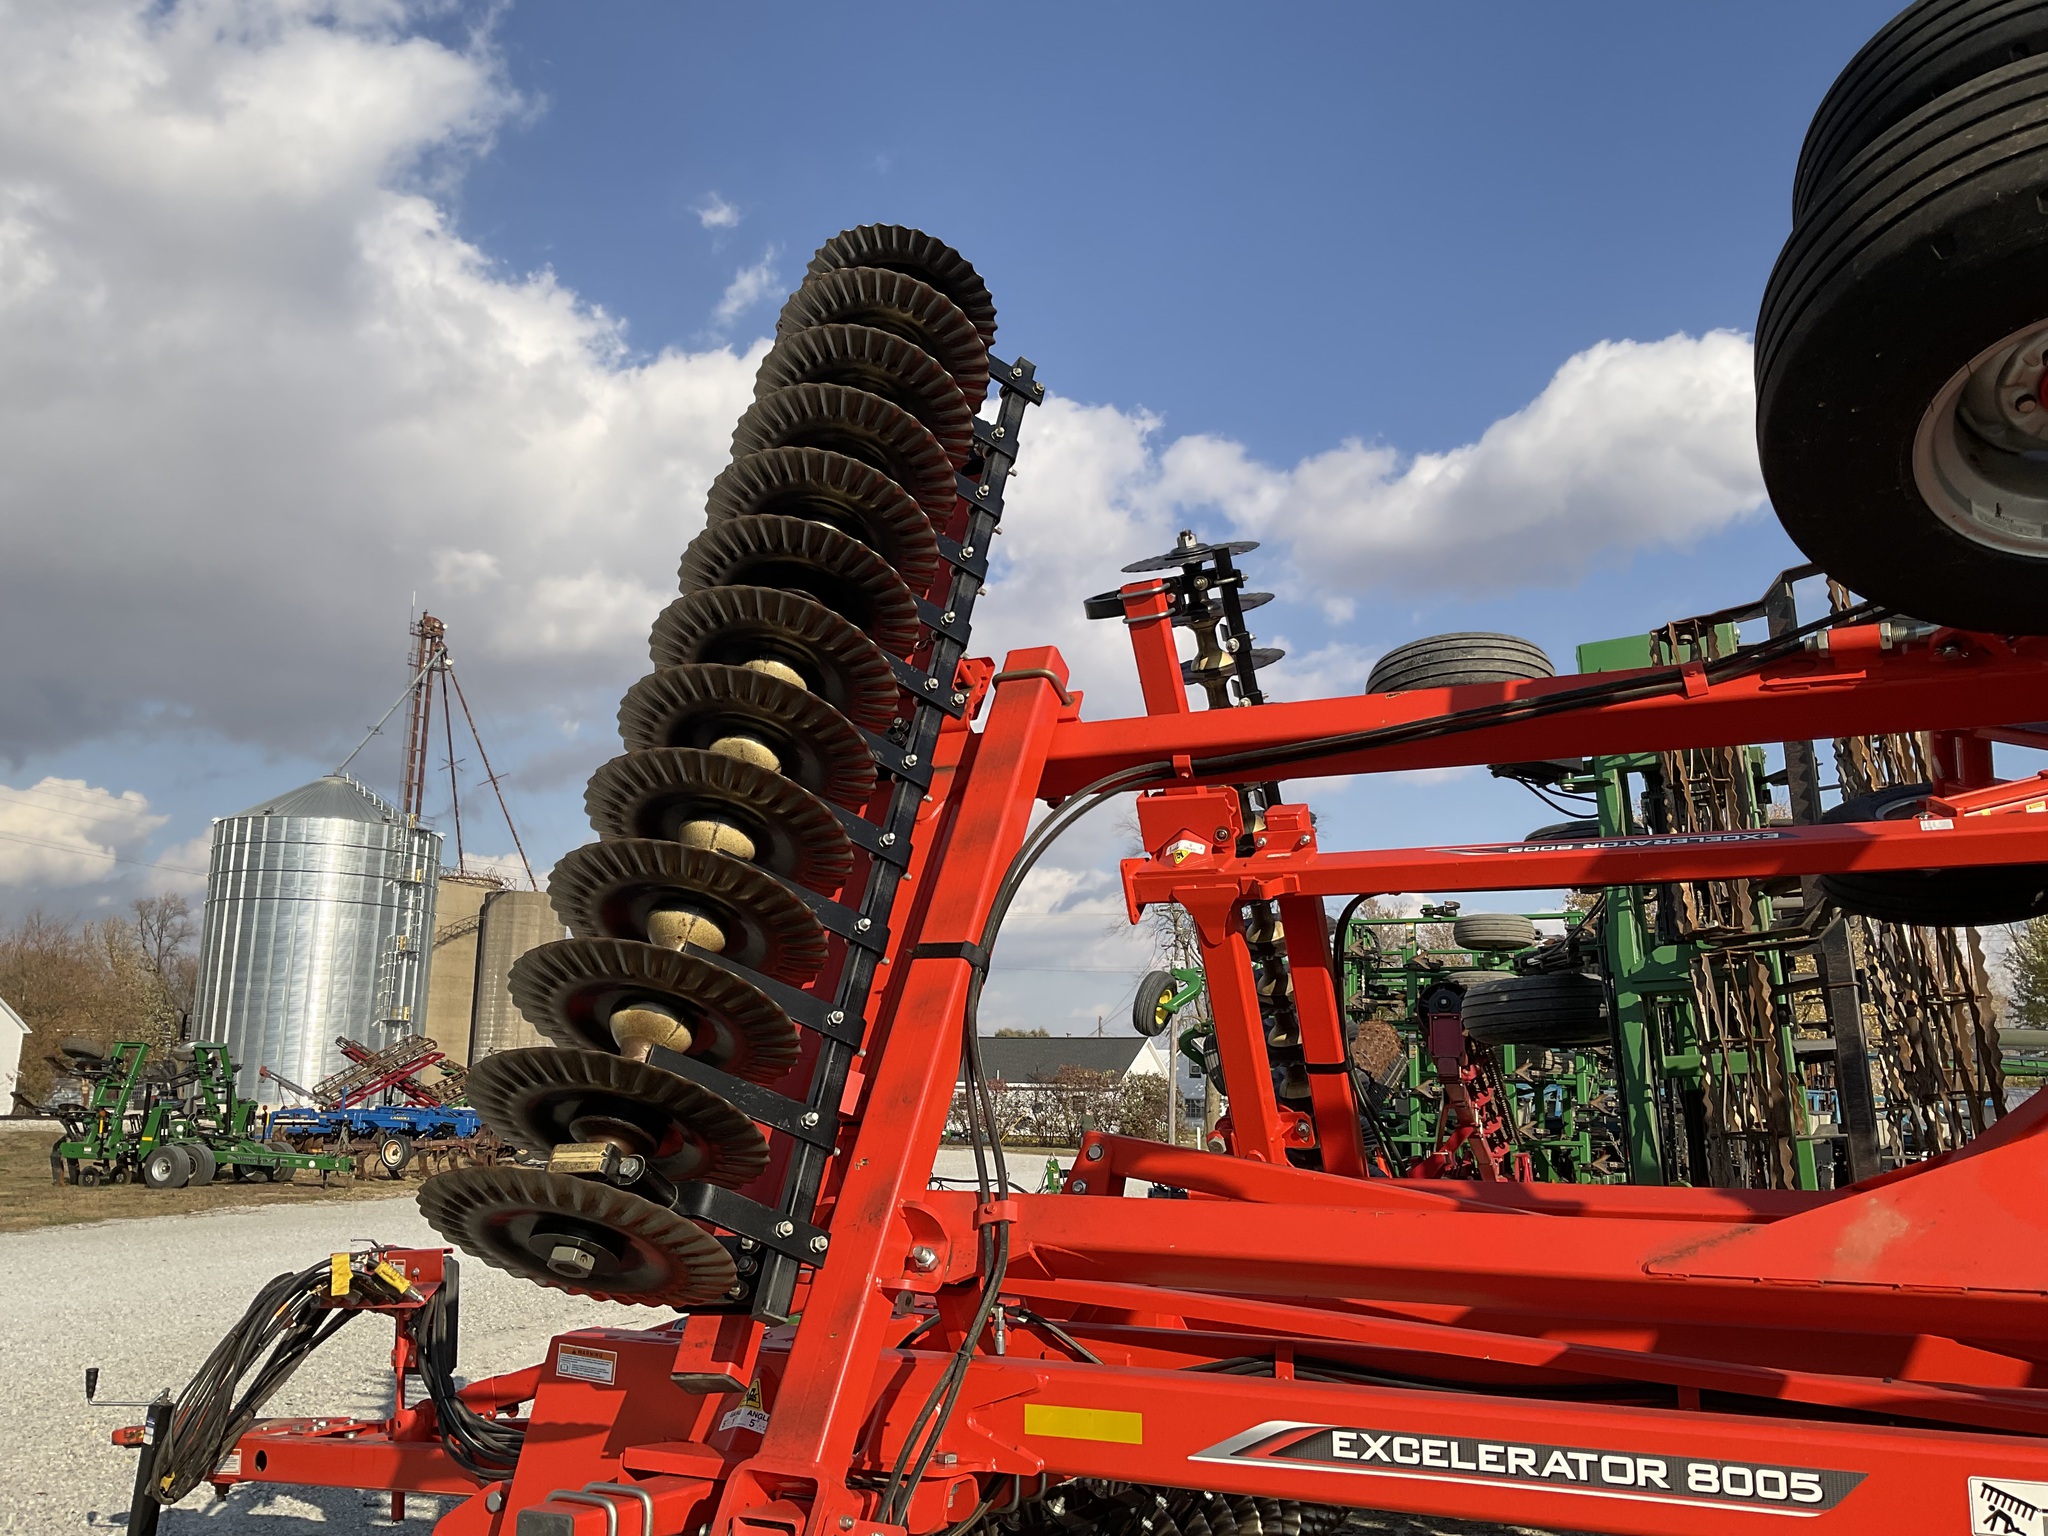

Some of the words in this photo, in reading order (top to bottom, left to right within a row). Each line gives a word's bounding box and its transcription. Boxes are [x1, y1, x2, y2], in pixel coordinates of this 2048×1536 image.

[1507, 844, 1574, 853] 8005
[1582, 832, 1779, 849] EXCELERATOR
[1331, 1430, 1672, 1490] EXCELERATOR
[1687, 1463, 1824, 1504] 8005
